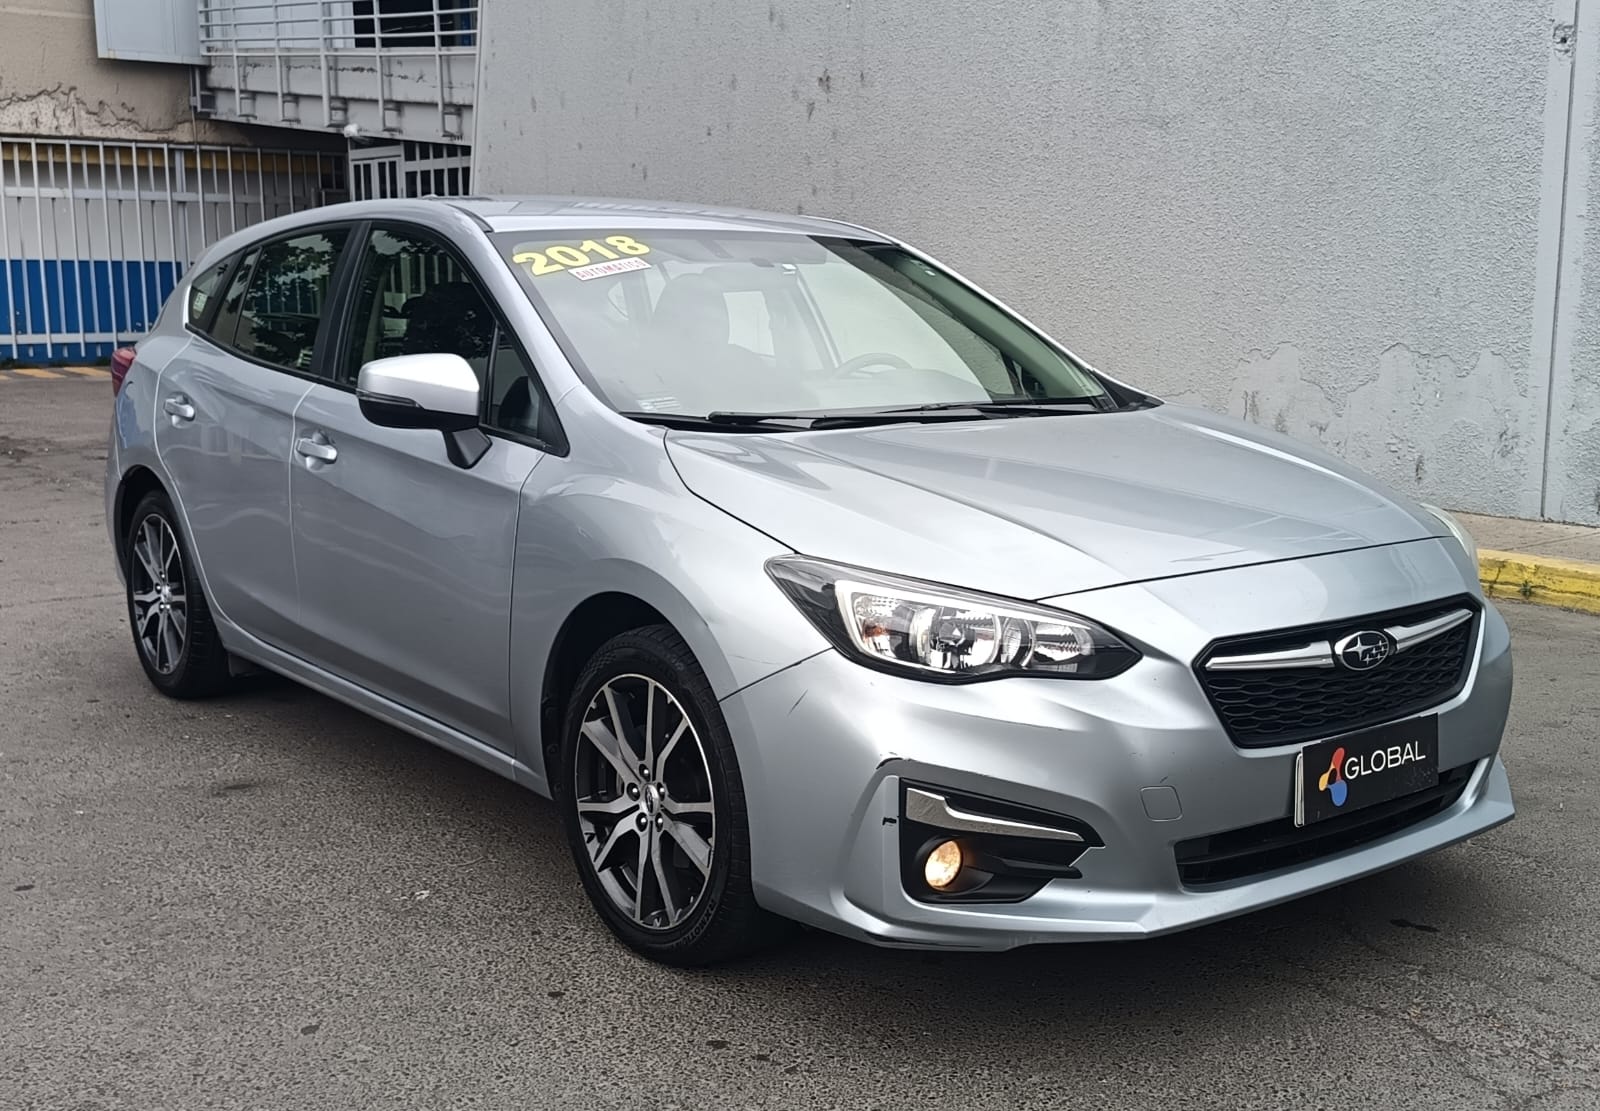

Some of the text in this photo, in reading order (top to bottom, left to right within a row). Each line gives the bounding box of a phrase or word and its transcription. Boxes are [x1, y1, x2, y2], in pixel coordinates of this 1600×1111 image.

[513, 235, 651, 276] 2018
[574, 258, 648, 279] AUTOMATICO
[1344, 740, 1426, 780] GLOBAL
